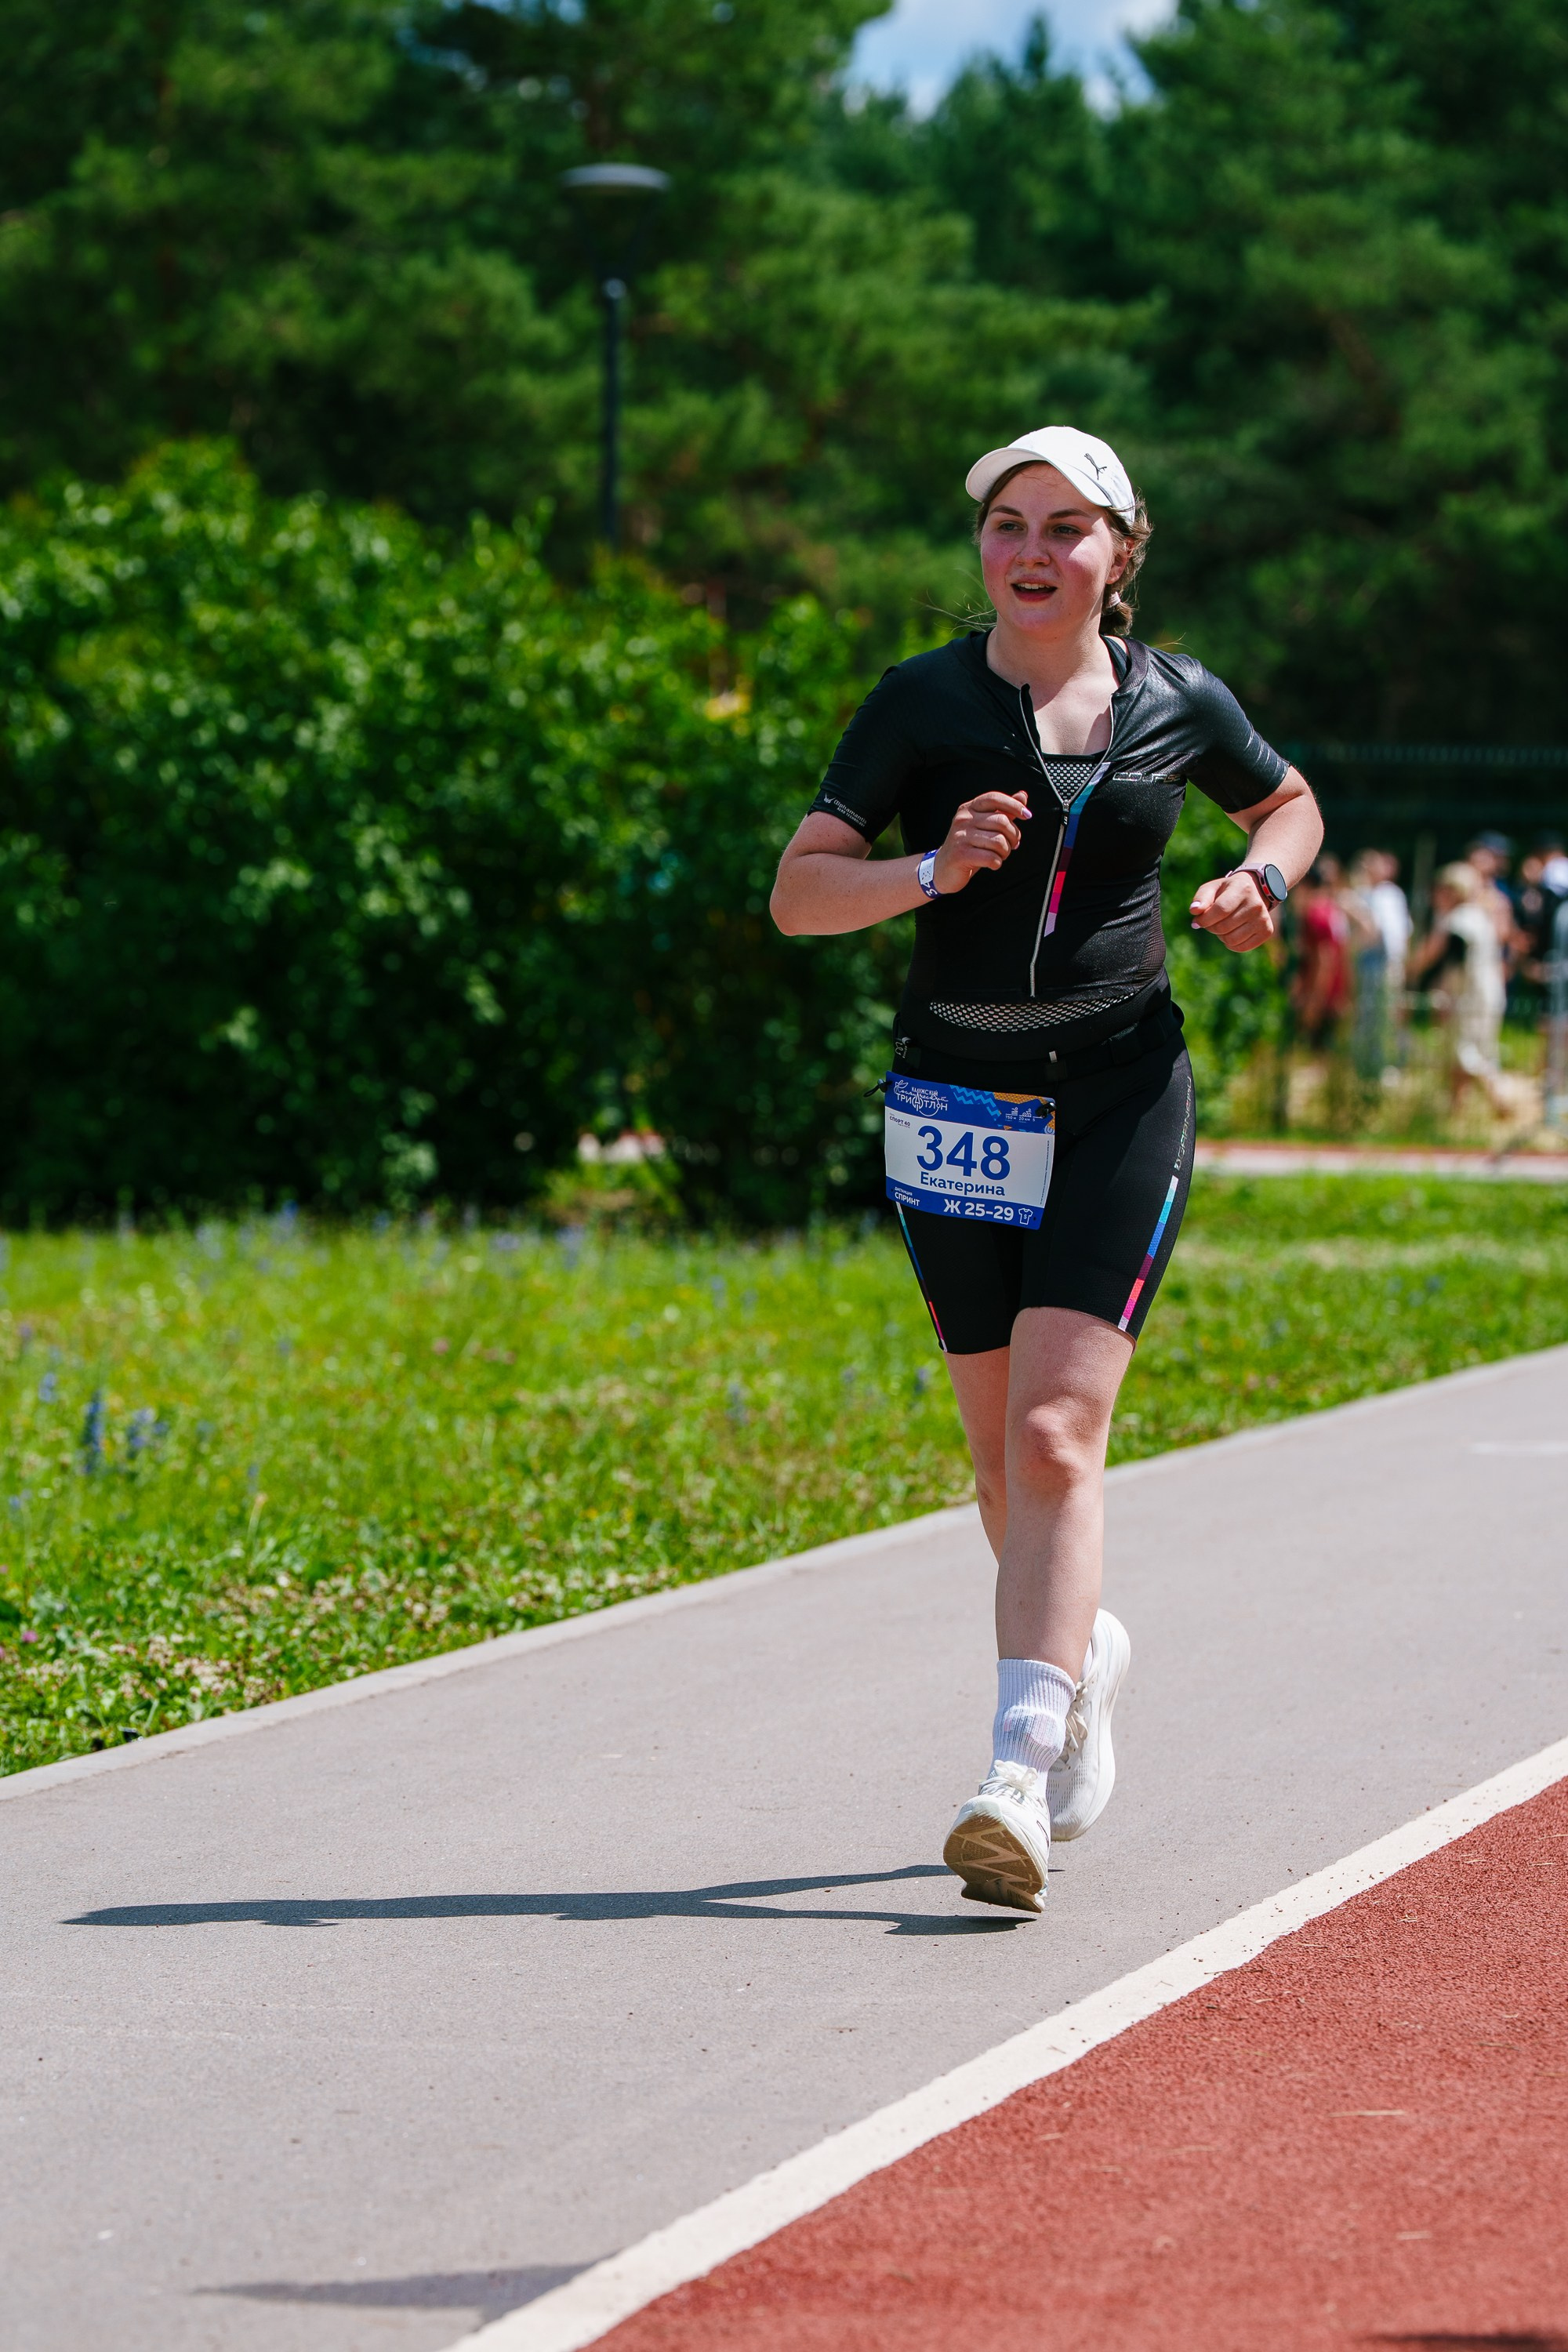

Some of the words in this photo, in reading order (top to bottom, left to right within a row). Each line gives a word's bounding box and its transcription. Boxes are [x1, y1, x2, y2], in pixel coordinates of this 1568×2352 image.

[895, 1092, 948, 1112] ТРИАТЛОН
[916, 1125, 1011, 1181] 348
[894, 1186, 913, 1196] ДИСТАНЦИЯ
[920, 1171, 1006, 1196] Екатерина
[895, 1192, 920, 1207] СПРИНТ
[943, 1199, 961, 1214] Ж
[964, 1202, 1014, 1221] 25-29
